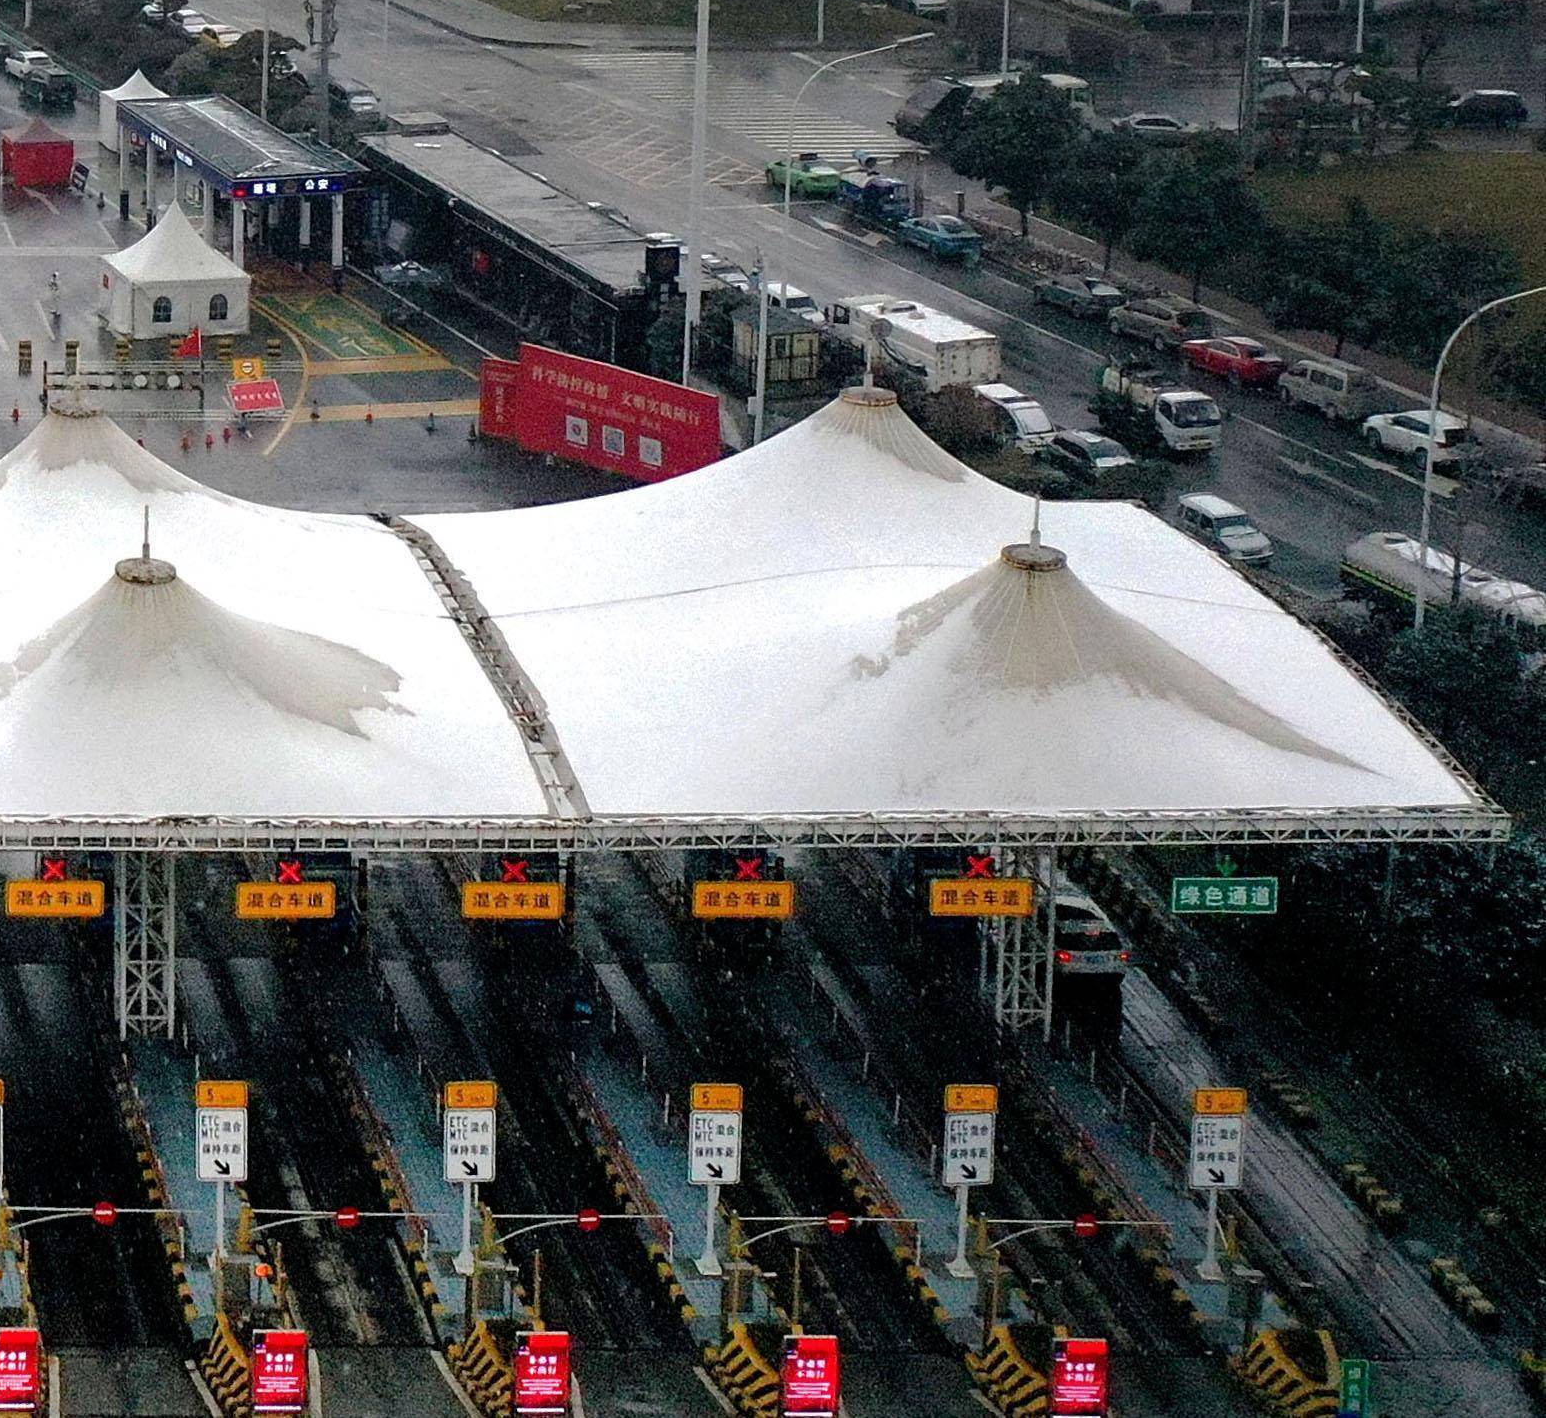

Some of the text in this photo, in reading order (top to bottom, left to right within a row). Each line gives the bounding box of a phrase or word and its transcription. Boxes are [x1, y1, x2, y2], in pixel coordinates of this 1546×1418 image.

[16, 890, 93, 906] 混合车道
[247, 892, 325, 908] 混合车道
[472, 892, 550, 908] 混合车道
[703, 891, 781, 907] 混合车道
[941, 889, 1022, 906] 混合车道
[1179, 886, 1271, 906] 绿色通道
[201, 1115, 219, 1127] ETC
[450, 1116, 468, 1128] ETC
[695, 1117, 713, 1130] ETC
